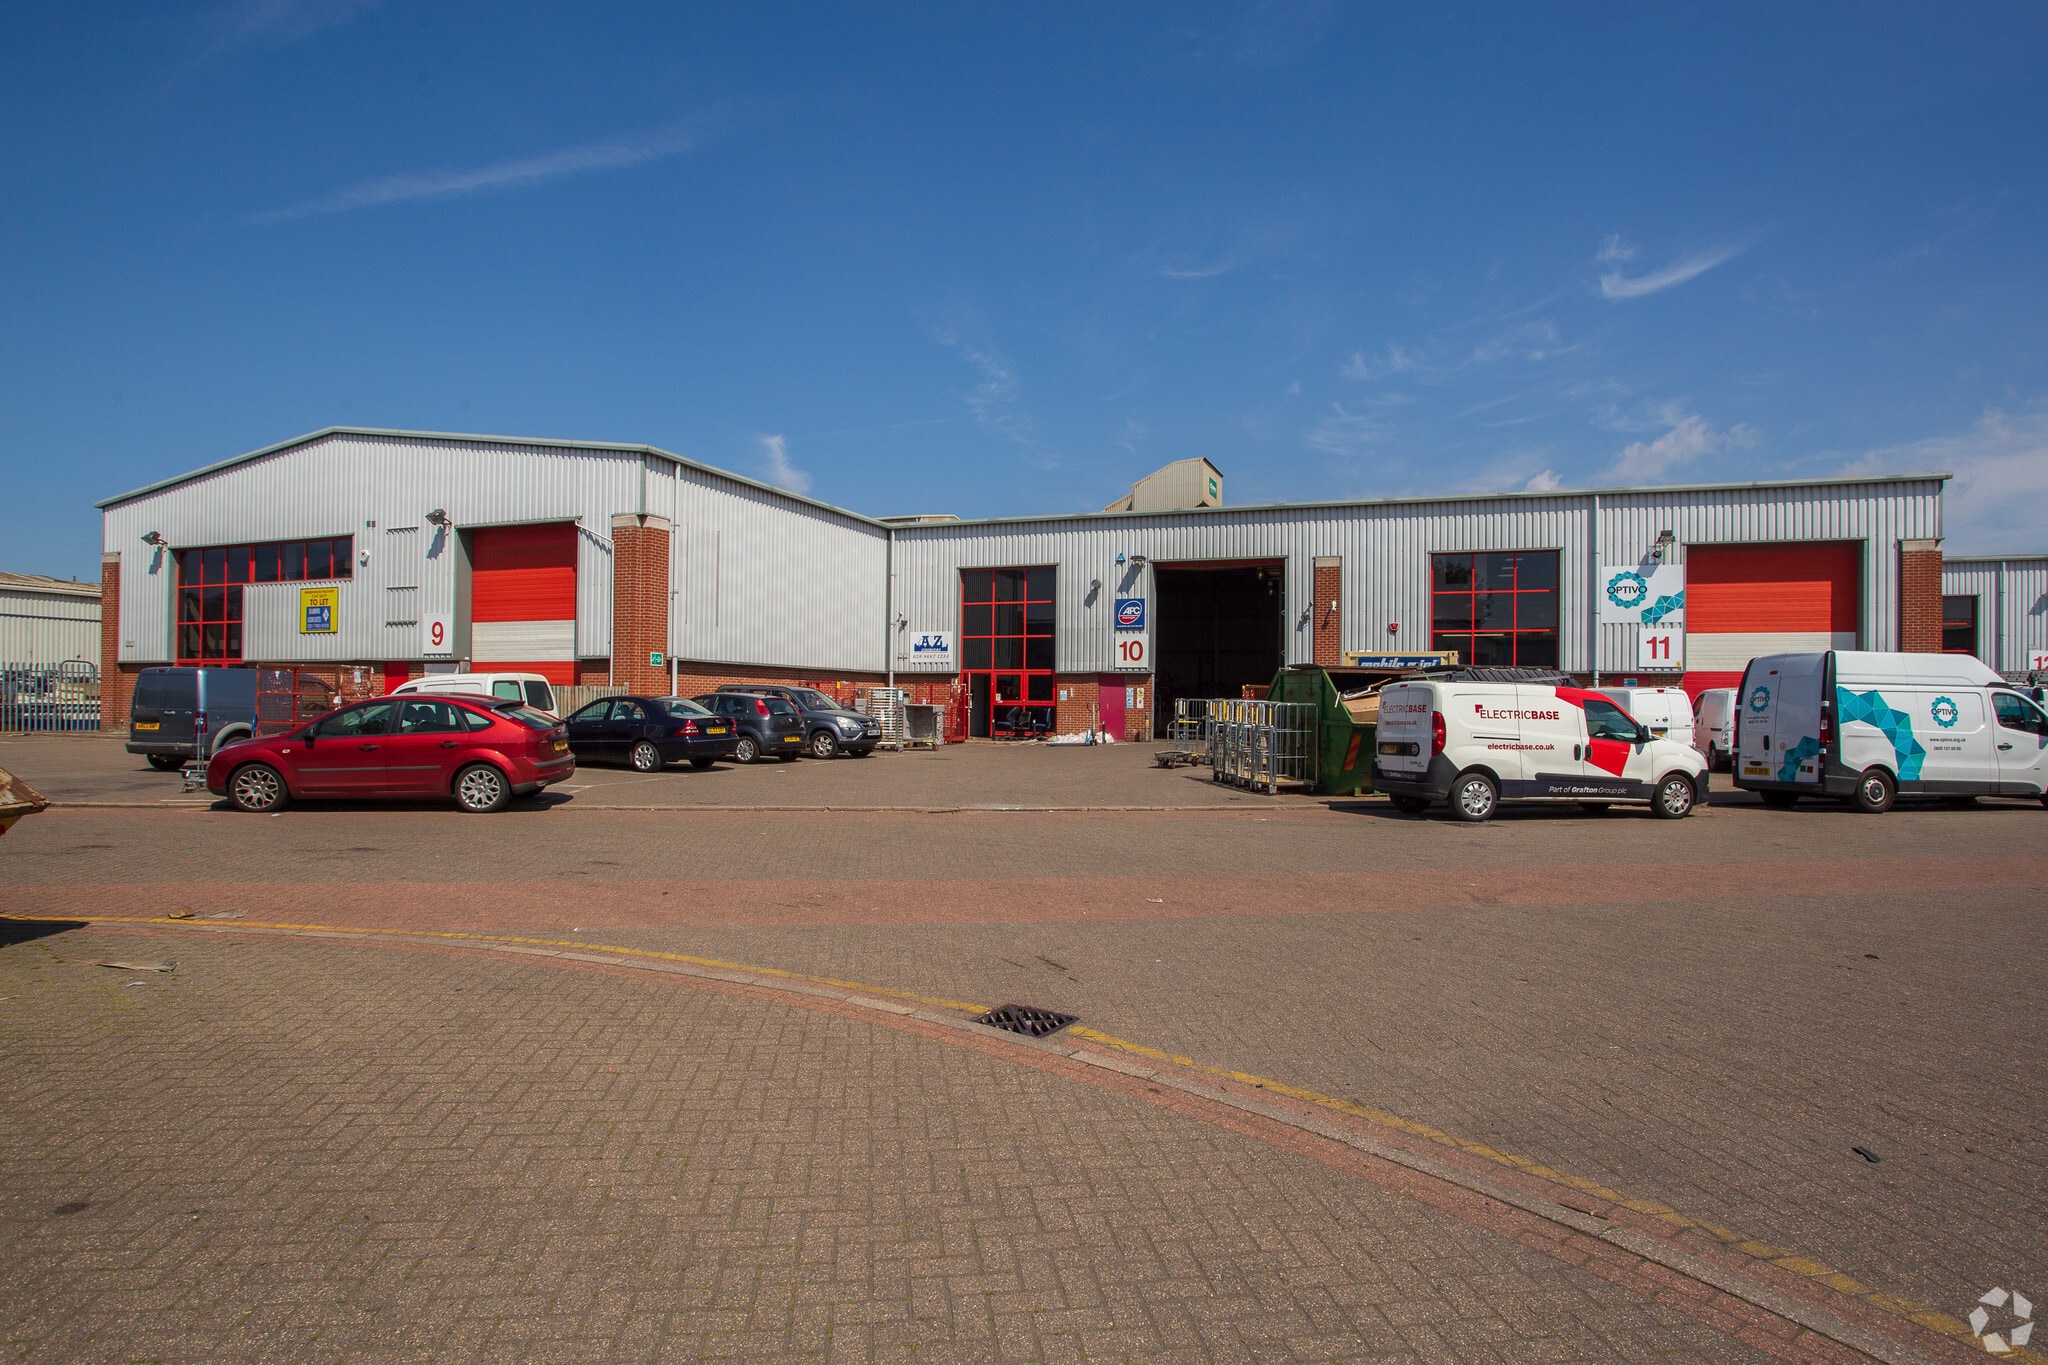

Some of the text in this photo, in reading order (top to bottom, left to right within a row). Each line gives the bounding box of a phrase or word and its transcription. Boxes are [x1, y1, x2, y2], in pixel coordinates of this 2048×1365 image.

[1607, 586, 1647, 594] OPTIVO
[1122, 606, 1141, 615] APC
[431, 621, 444, 646] 9
[1119, 640, 1144, 662] 10
[1646, 636, 1670, 659] 11
[1749, 695, 1770, 703] OPTIVO
[1383, 704, 1427, 714] ELECTRICBASE
[1931, 708, 1958, 716] OPTIVO
[1480, 709, 1560, 720] ELECTRICBASE
